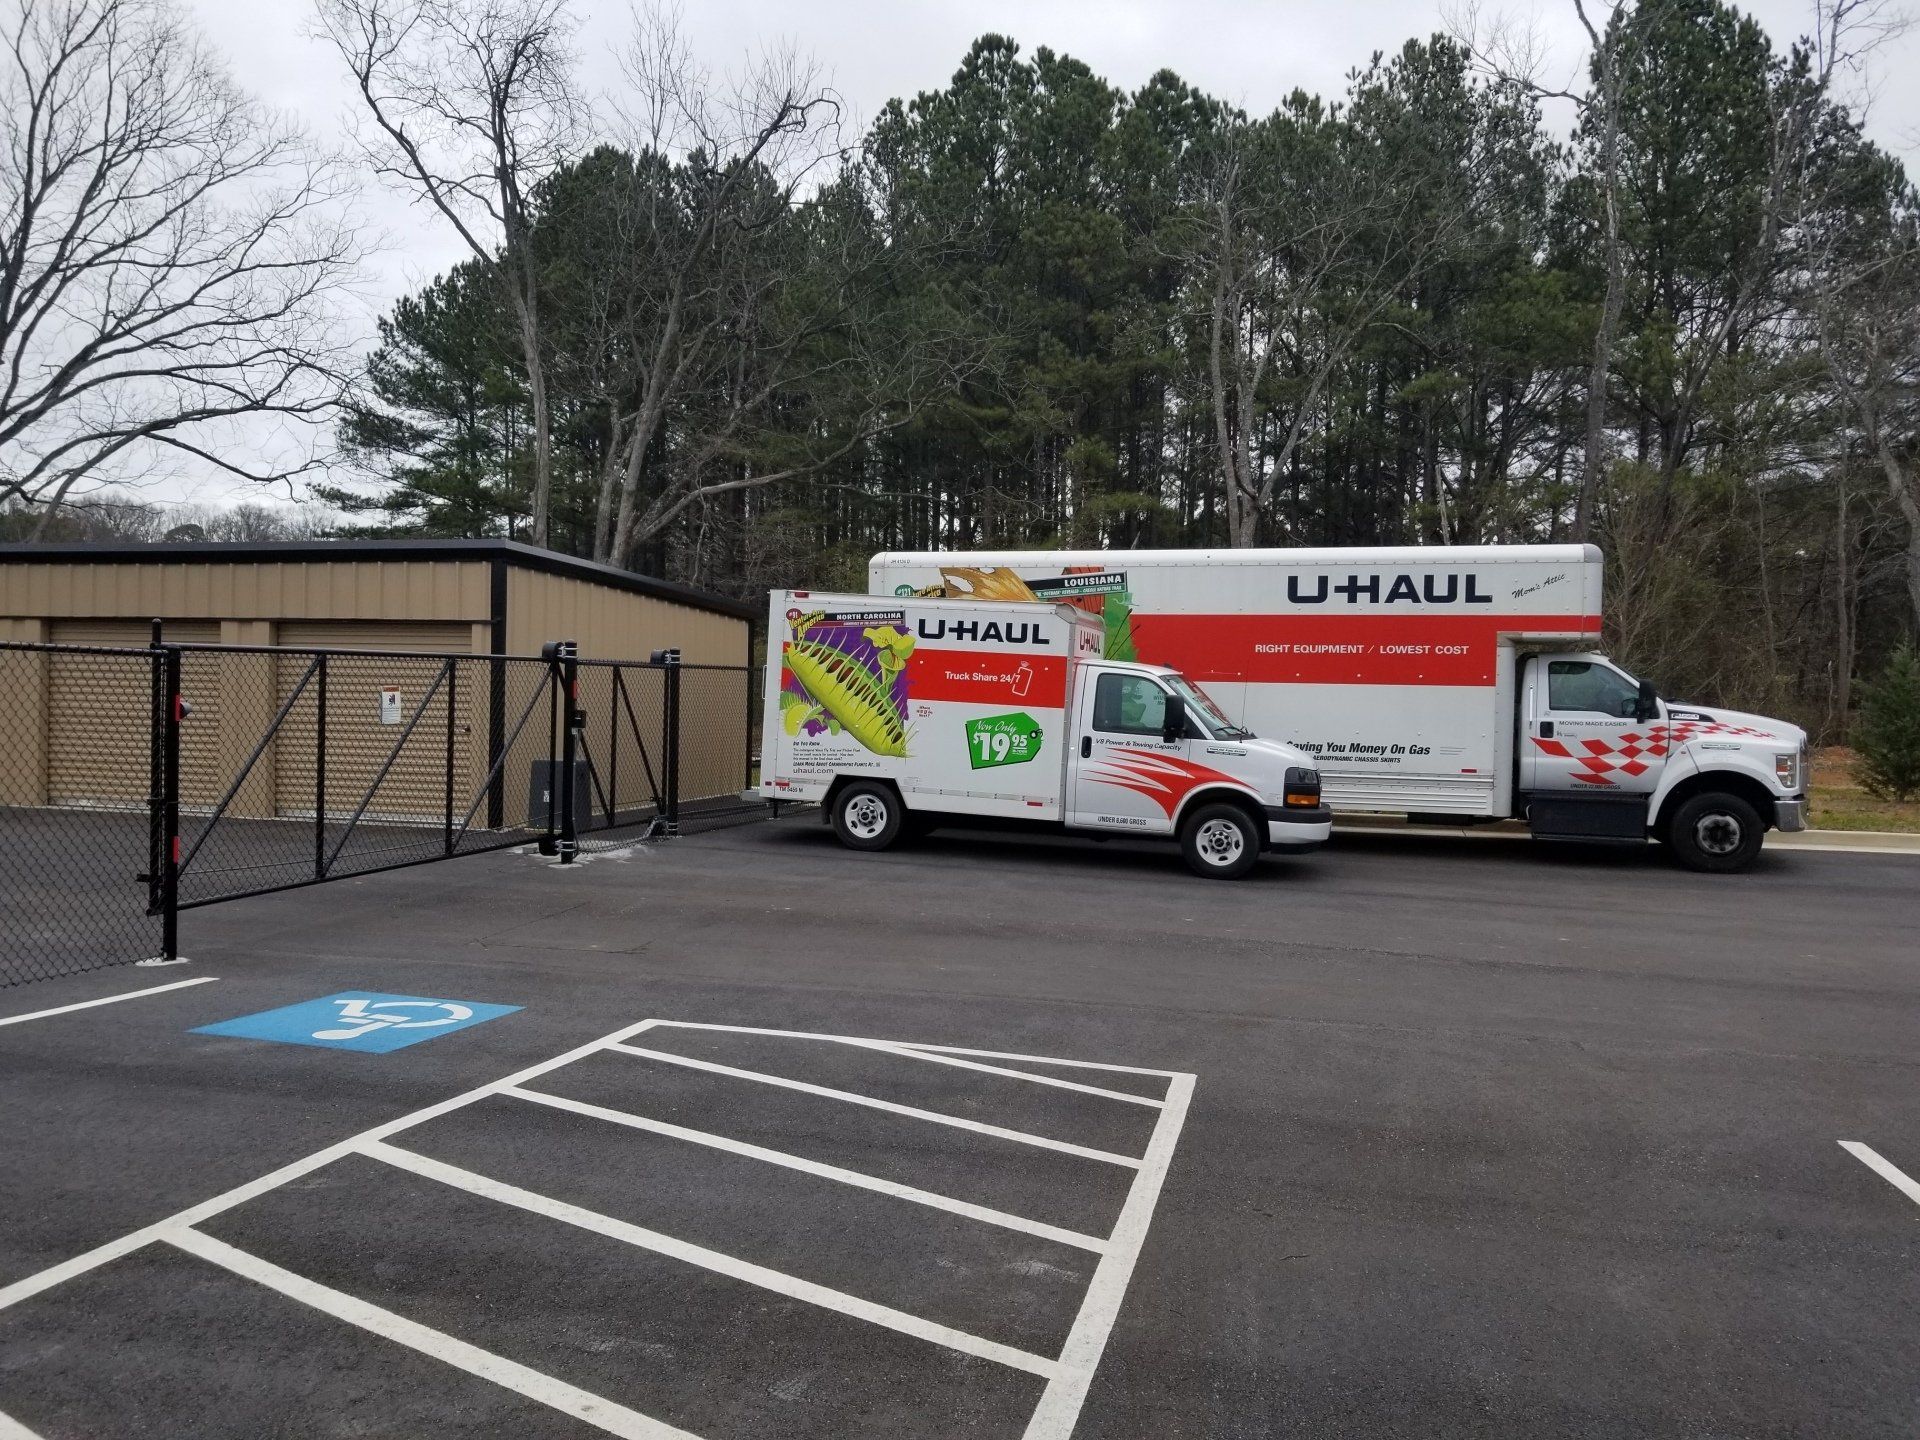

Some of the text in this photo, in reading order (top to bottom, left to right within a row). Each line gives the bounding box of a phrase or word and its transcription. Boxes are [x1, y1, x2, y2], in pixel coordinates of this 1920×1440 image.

[1064, 574, 1122, 587] LOUISIANA
[1511, 574, 1565, 599] Mom's Attic
[863, 612, 902, 620] CAROLINA
[1254, 644, 1290, 653] RIGHT
[1293, 644, 1365, 654] EQUIPMENT
[1379, 645, 1431, 654] LOWEST
[1435, 645, 1470, 655] COST
[944, 671, 1021, 685] Truck Share 24/7
[974, 720, 1017, 736] Now Only
[1132, 741, 1154, 750] Towing
[1154, 743, 1182, 752] Capacity
[1326, 742, 1347, 753] You
[1348, 742, 1388, 756] Money
[1390, 743, 1406, 755] On
[1408, 744, 1431, 755] Gas
[1097, 815, 1116, 823] UNDER
[1129, 818, 1147, 826] GROSS
